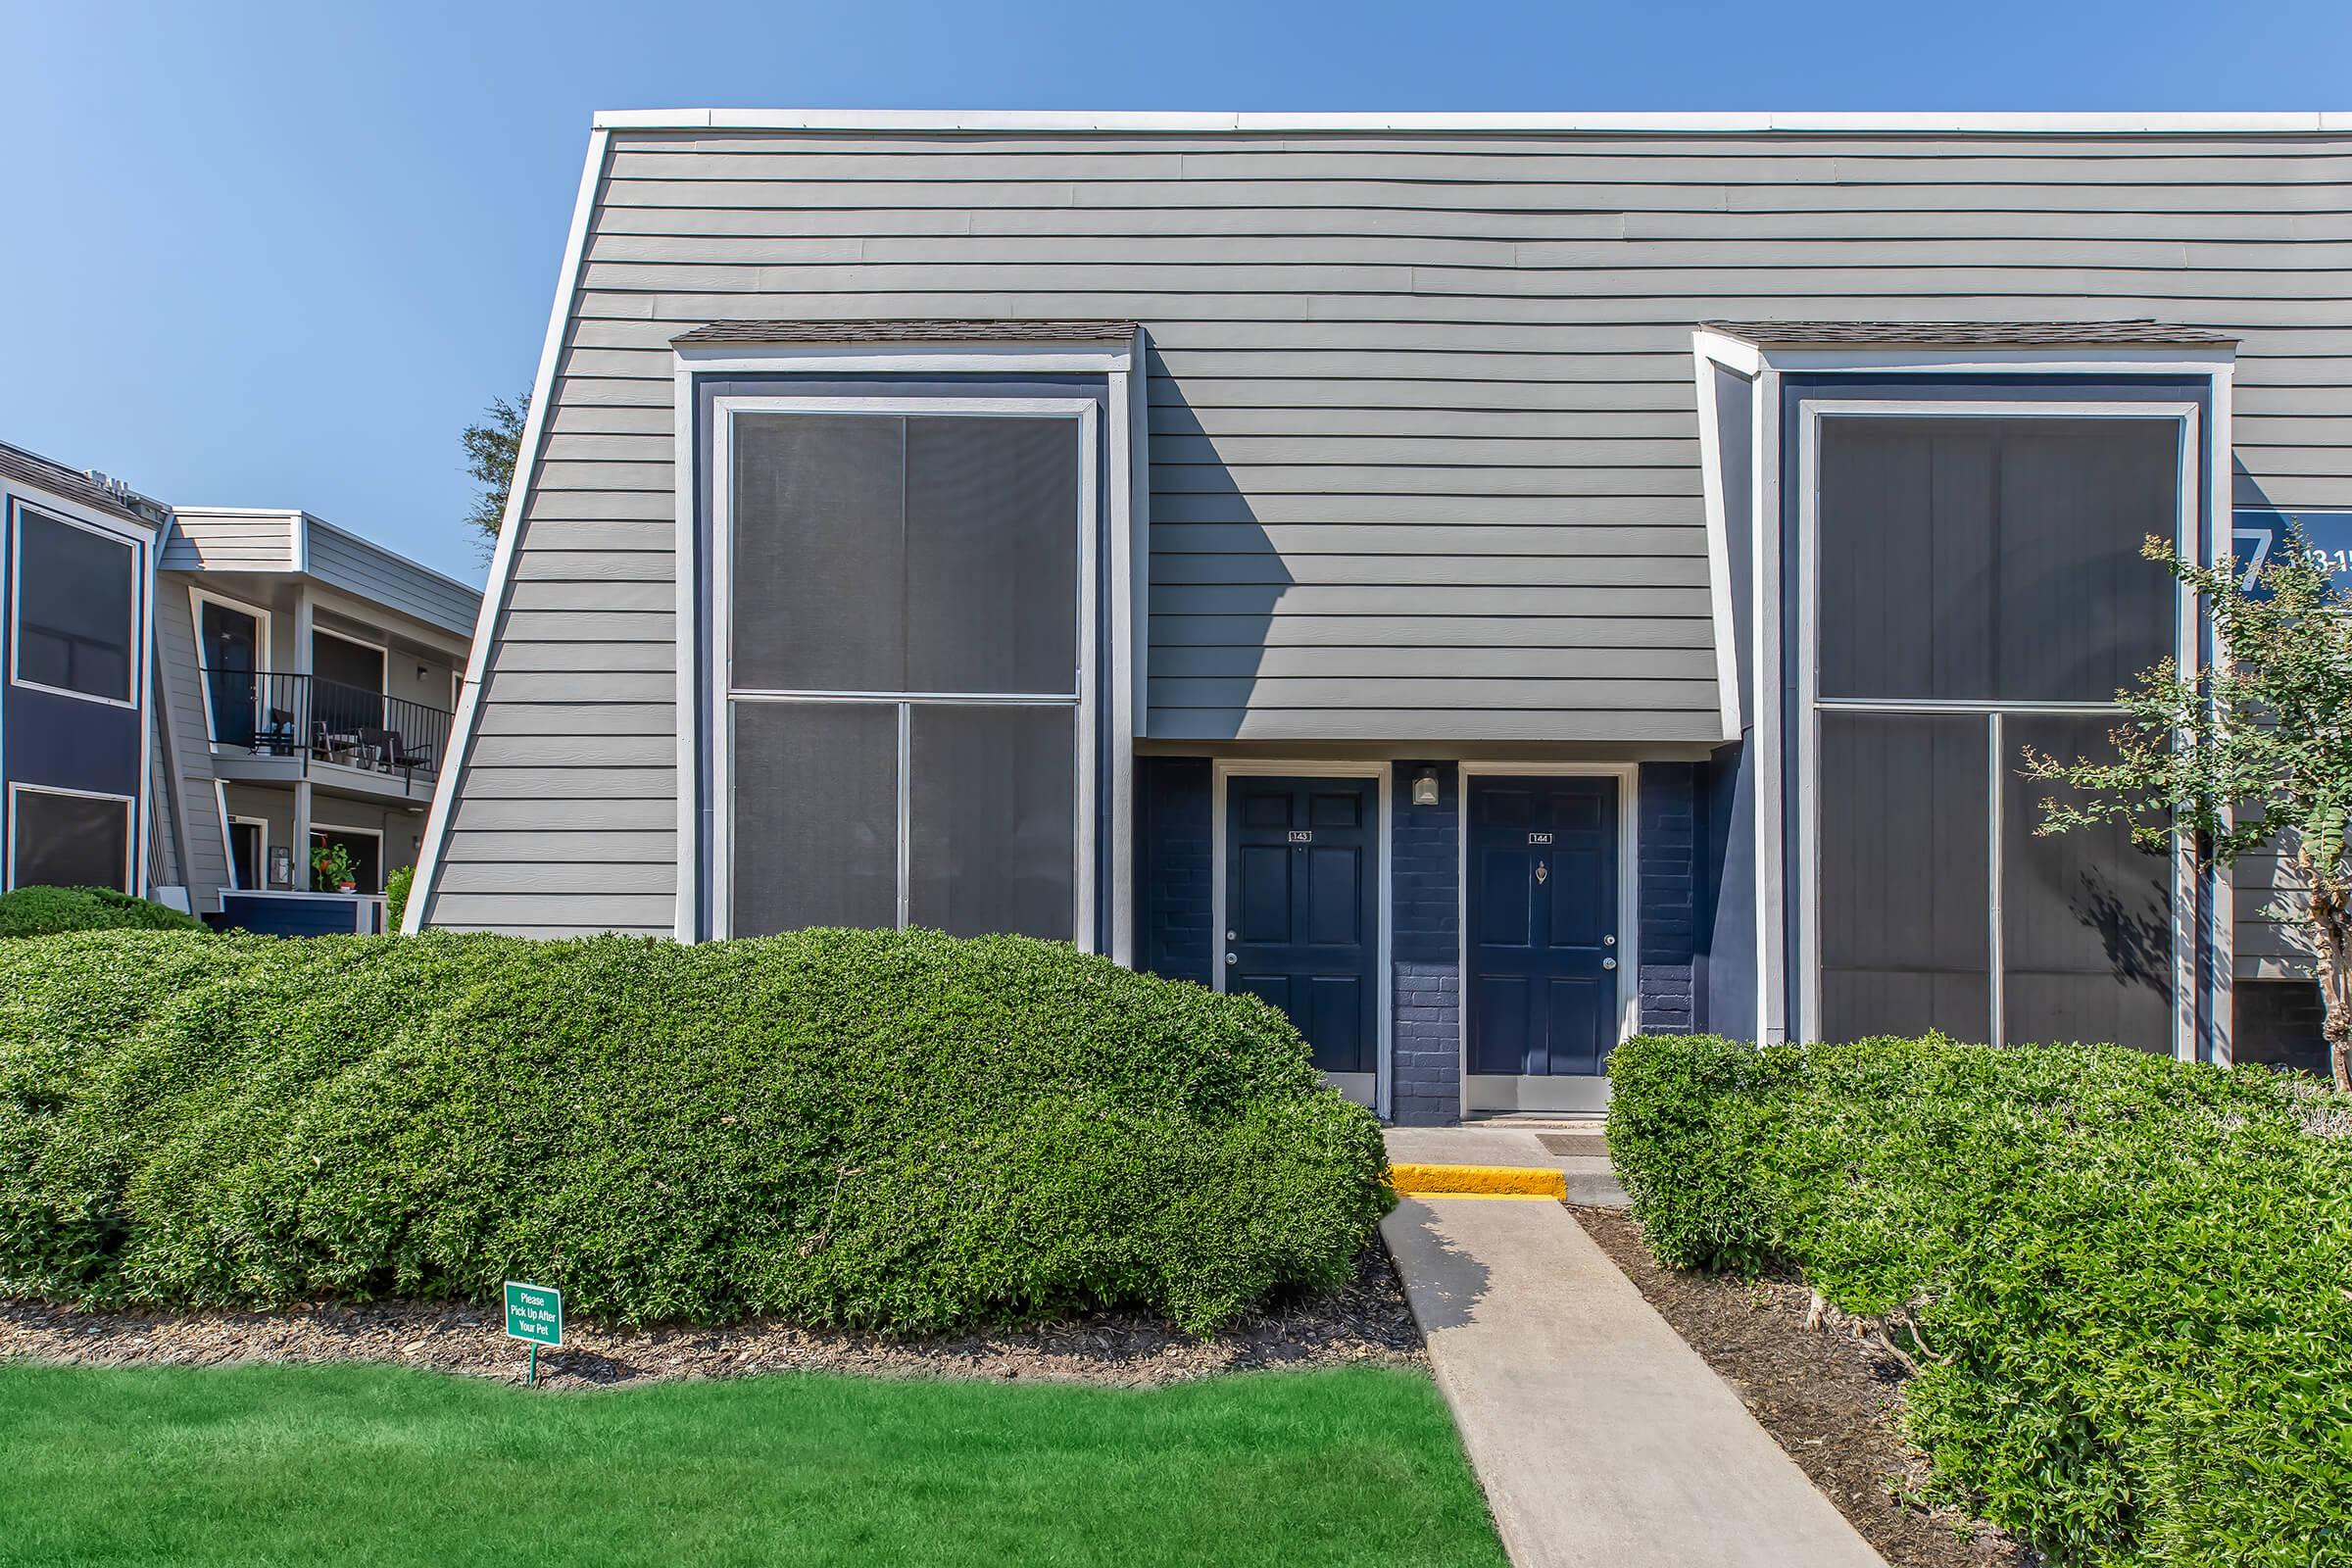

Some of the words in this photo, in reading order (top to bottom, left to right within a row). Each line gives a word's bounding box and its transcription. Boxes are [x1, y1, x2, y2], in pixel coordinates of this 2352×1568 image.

[2231, 528, 2273, 592] 7
[520, 1292, 545, 1306] Please
[511, 1304, 526, 1317] Pick
[527, 1307, 538, 1321] Up
[538, 1309, 556, 1323] After
[519, 1319, 535, 1333] Your
[536, 1323, 549, 1336] Pet
